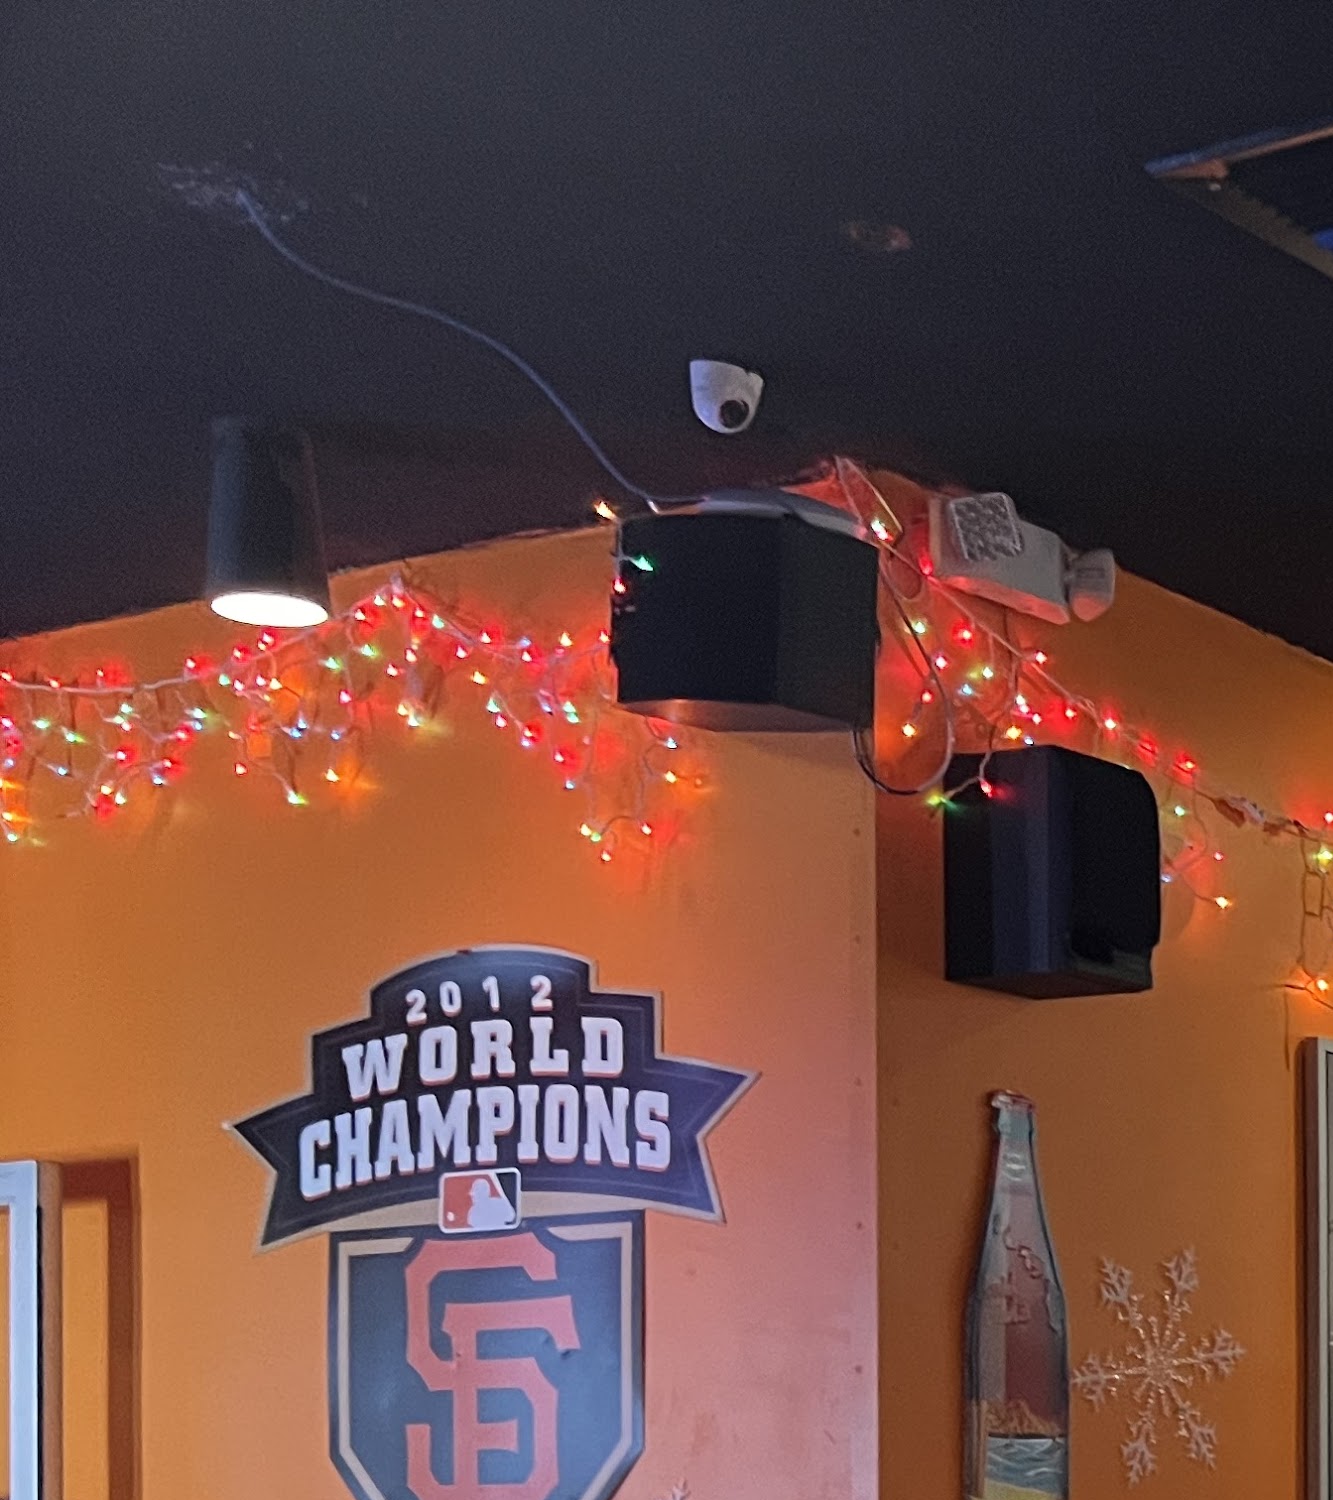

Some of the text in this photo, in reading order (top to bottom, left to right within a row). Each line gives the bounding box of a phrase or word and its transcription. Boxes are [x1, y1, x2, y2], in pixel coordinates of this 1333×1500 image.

[405, 974, 554, 1024] 2012
[340, 1015, 626, 1101] WORLD
[298, 1081, 673, 1201] CHAMPIONS
